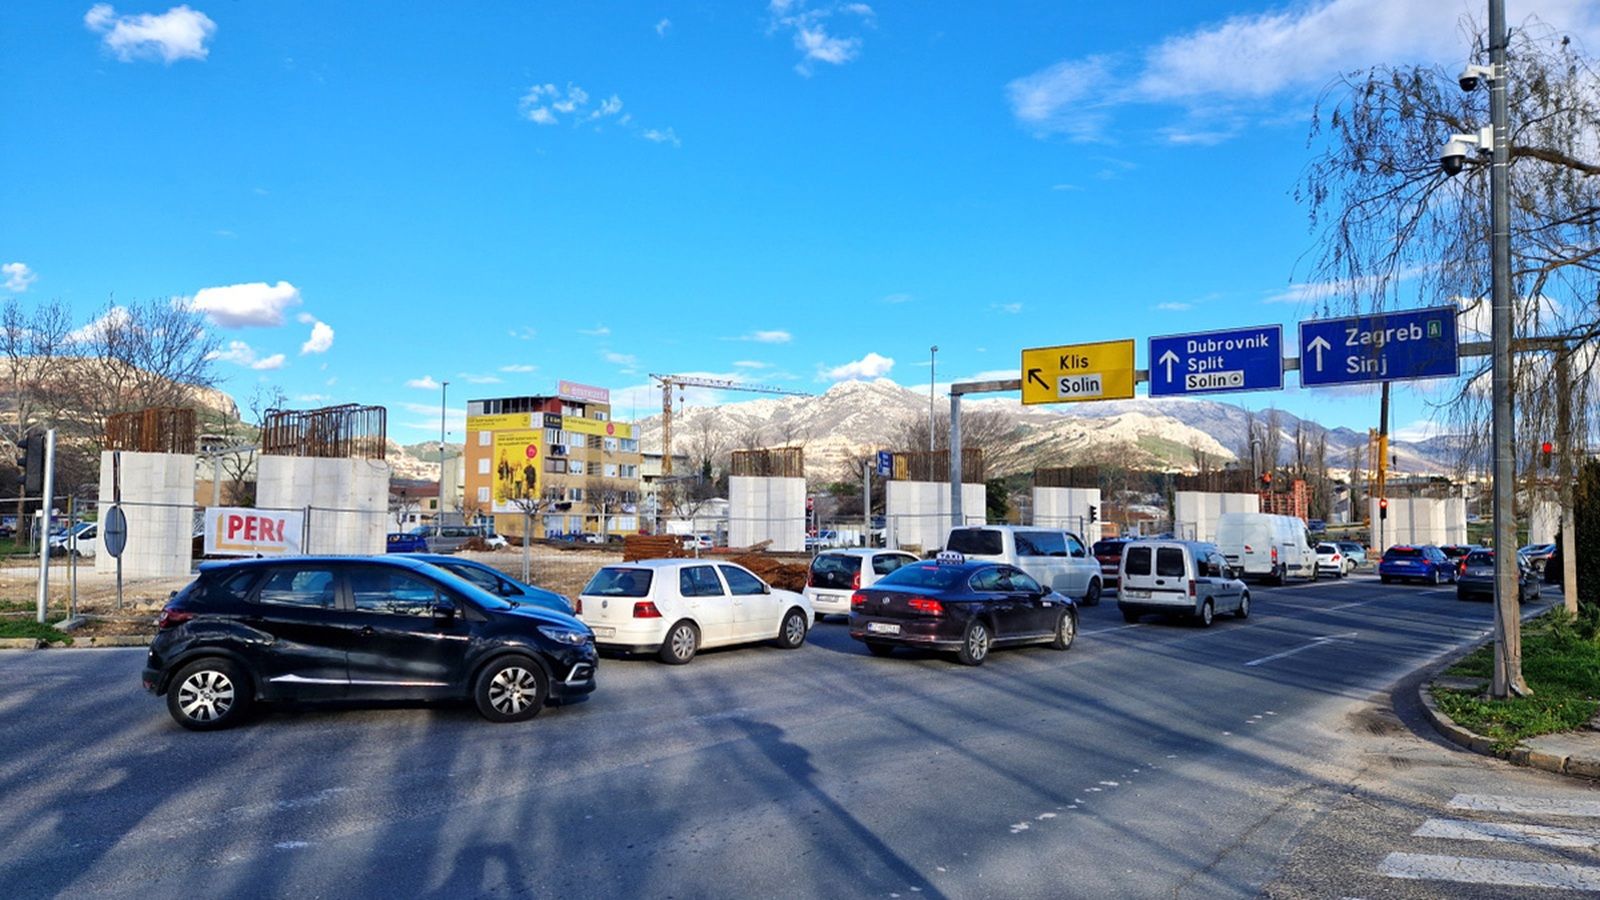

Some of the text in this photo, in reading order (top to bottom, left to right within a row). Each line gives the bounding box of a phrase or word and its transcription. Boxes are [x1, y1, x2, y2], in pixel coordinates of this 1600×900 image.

[1187, 333, 1269, 354] Dubrovnik
[1345, 322, 1423, 348] Zagreb
[1060, 354, 1089, 370] Klis
[1188, 355, 1224, 373] Split
[1346, 354, 1388, 375] Sinj
[1060, 377, 1100, 394] Solin
[1188, 373, 1227, 388] Solin
